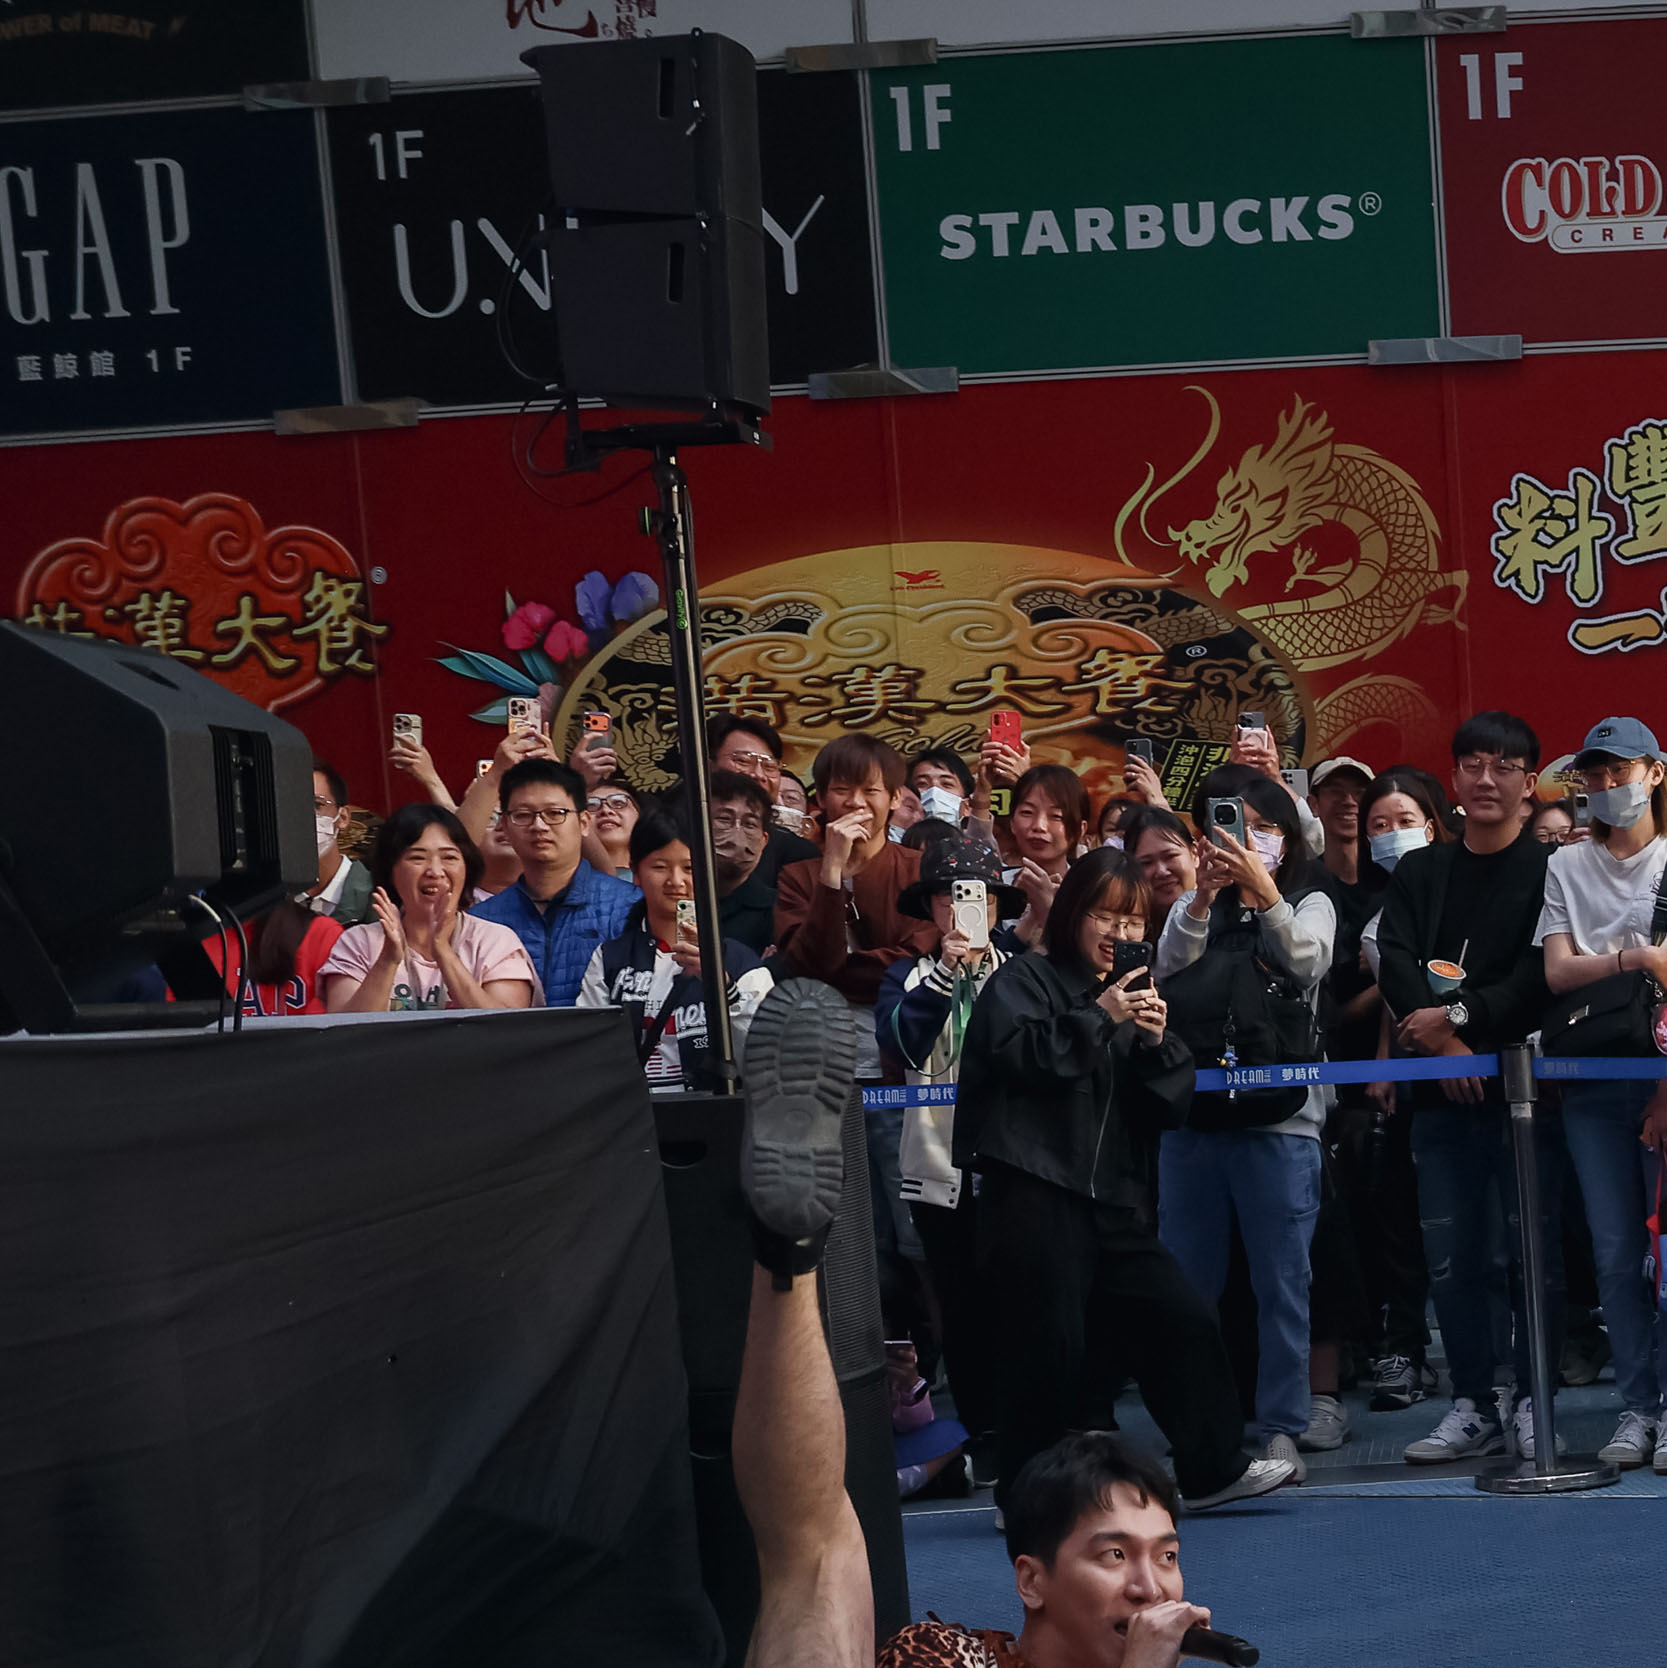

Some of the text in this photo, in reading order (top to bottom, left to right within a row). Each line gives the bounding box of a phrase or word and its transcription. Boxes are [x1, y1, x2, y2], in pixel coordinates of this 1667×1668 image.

[889, 83, 952, 153] 1F
[1459, 52, 1525, 121] 1F
[367, 129, 424, 183] 1F
[1504, 156, 1666, 241] COLD
[1281, 1066, 1320, 1081] 夢時代
